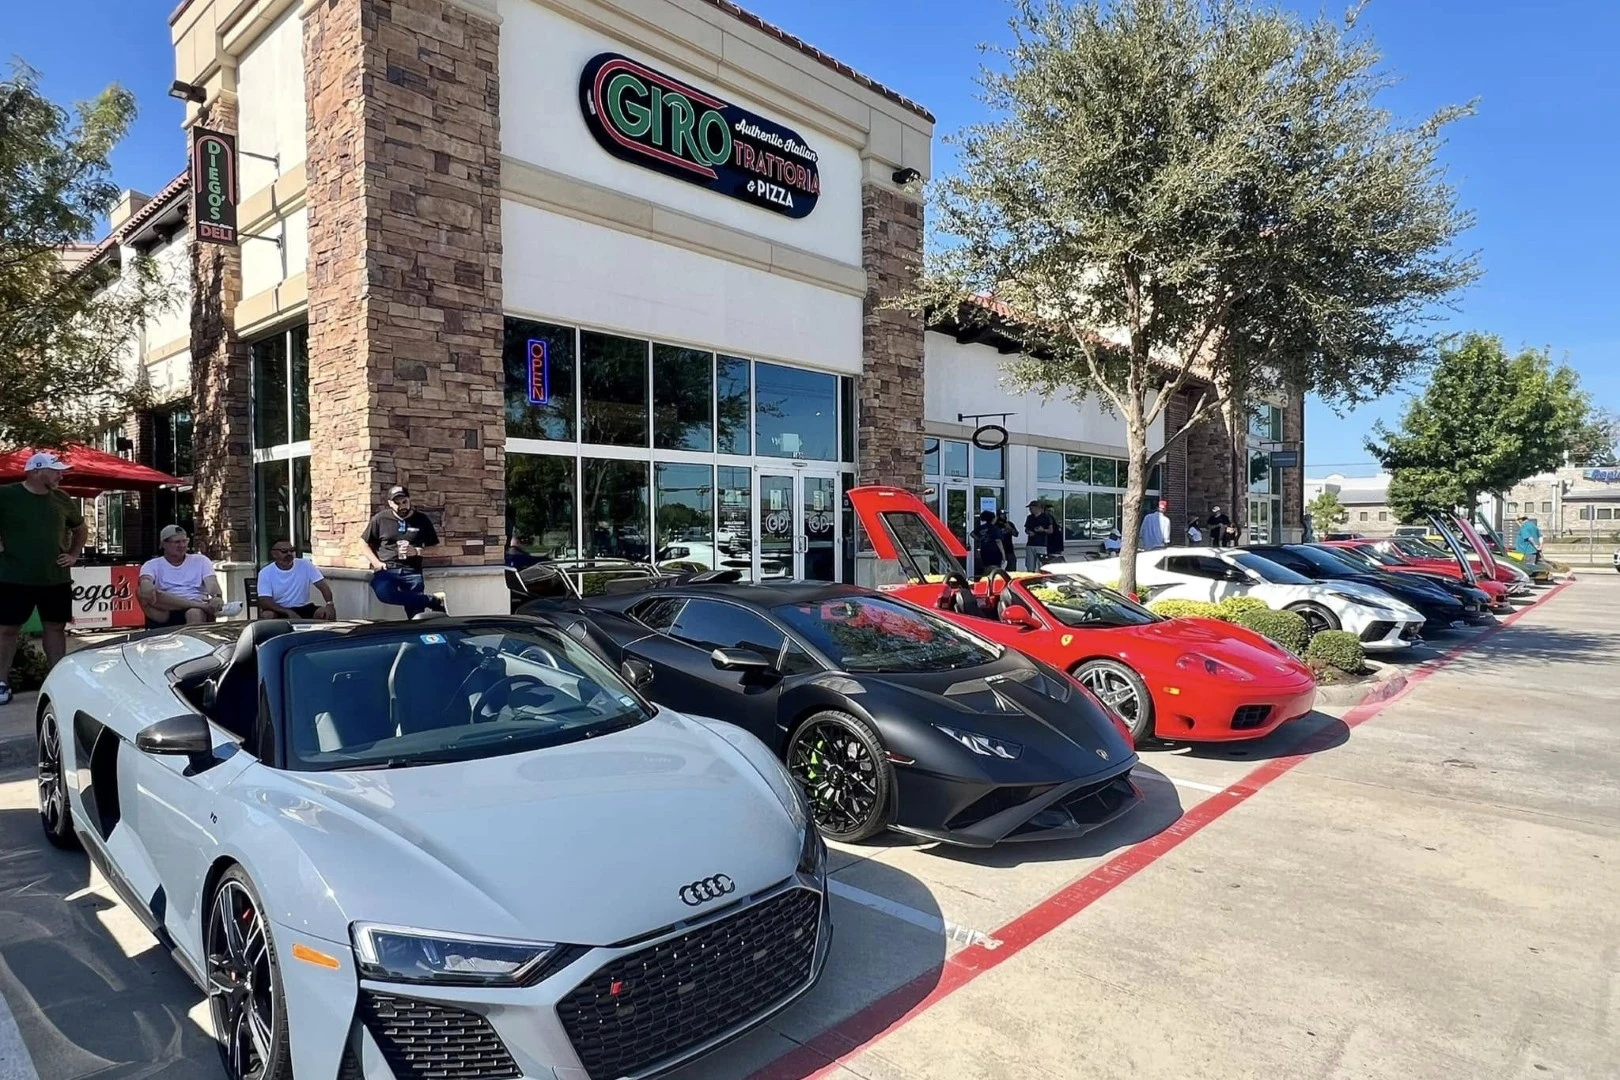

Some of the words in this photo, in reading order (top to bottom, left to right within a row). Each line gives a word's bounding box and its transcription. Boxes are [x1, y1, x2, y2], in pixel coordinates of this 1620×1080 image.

[607, 73, 732, 166] GIRO
[735, 118, 784, 148] Authentic
[783, 138, 819, 164] Italian
[207, 140, 226, 220] DIEGO'S
[733, 139, 821, 196] TRATTORIA
[747, 180, 756, 193] &
[757, 179, 794, 209] PIZZA
[200, 224, 233, 241] DELI
[531, 343, 544, 400] OPEN
[72, 575, 133, 612] ego's
